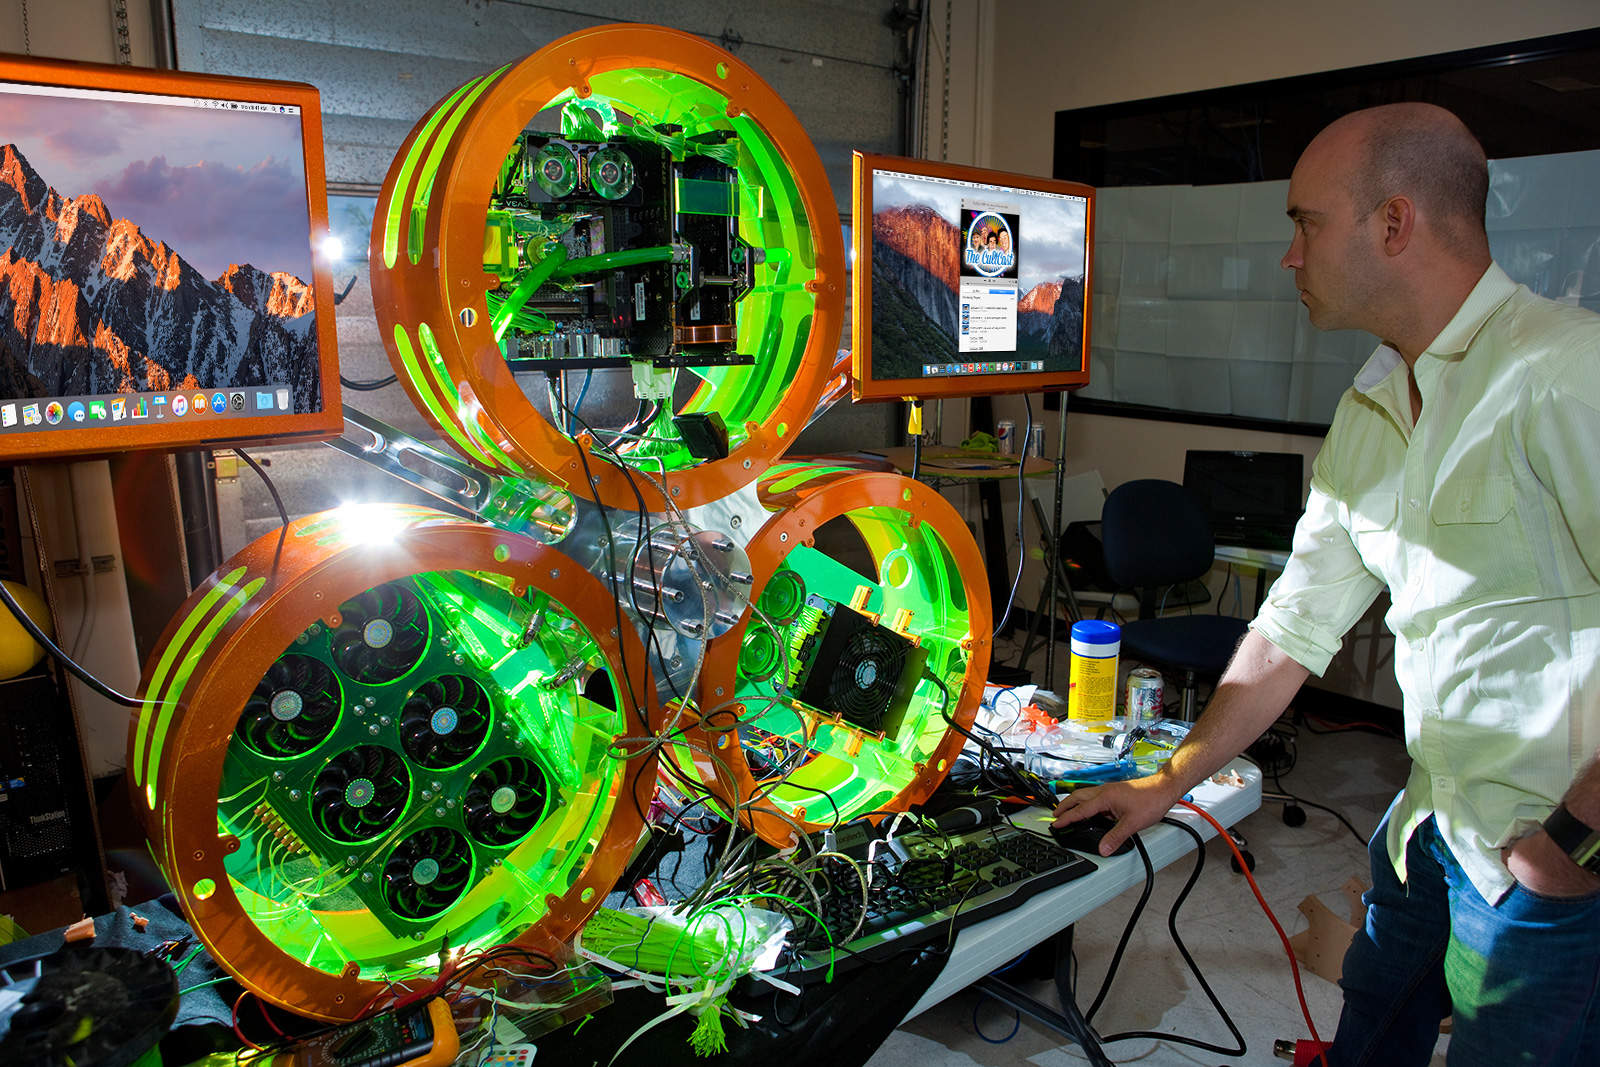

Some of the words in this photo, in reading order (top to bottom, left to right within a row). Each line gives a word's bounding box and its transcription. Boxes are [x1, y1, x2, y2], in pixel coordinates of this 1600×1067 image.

[966, 249, 980, 263] The
[981, 249, 1013, 265] CultCast
[29, 810, 65, 824] ThinkStation
